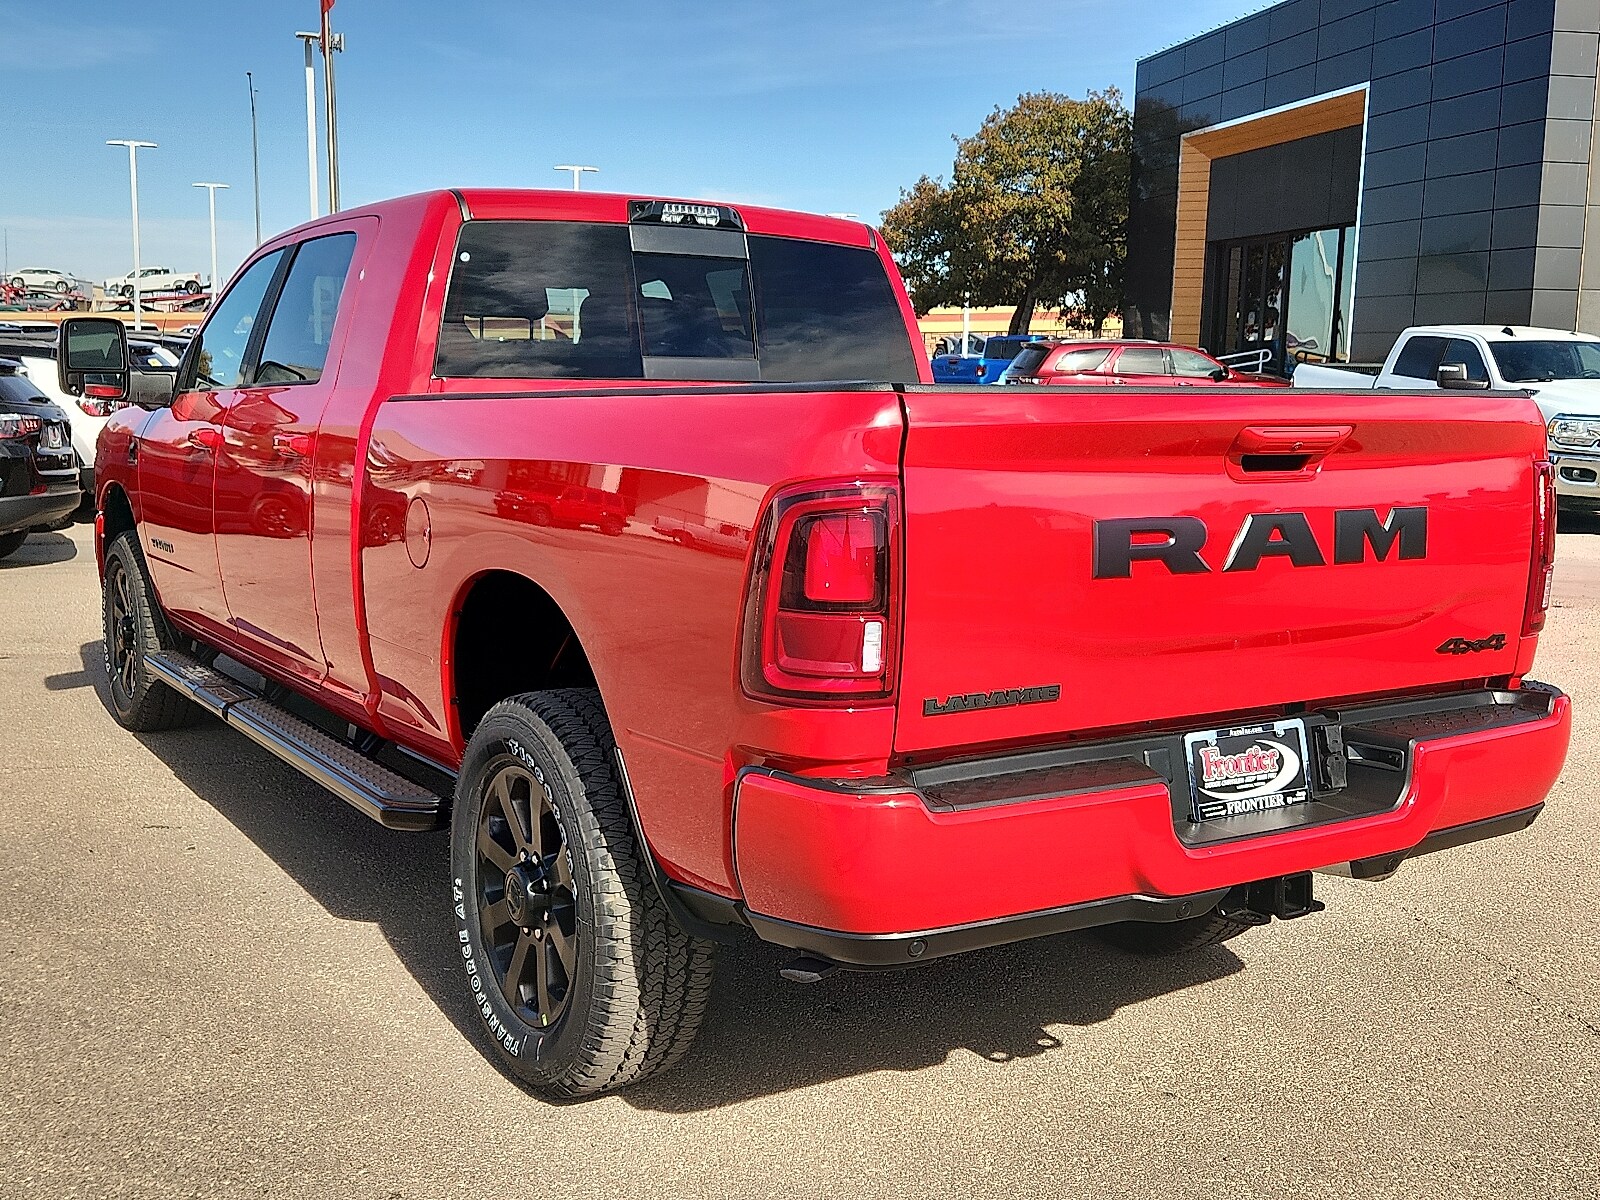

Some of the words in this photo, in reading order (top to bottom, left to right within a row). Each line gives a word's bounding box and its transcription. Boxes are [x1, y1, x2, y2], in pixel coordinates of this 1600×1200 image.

[1092, 506, 1428, 580] RAM
[922, 684, 1061, 717] LARAMIE
[1200, 746, 1279, 780] Frontier
[1226, 794, 1285, 815] FRONTIER
[458, 929, 520, 1057] TRANSFORCE
